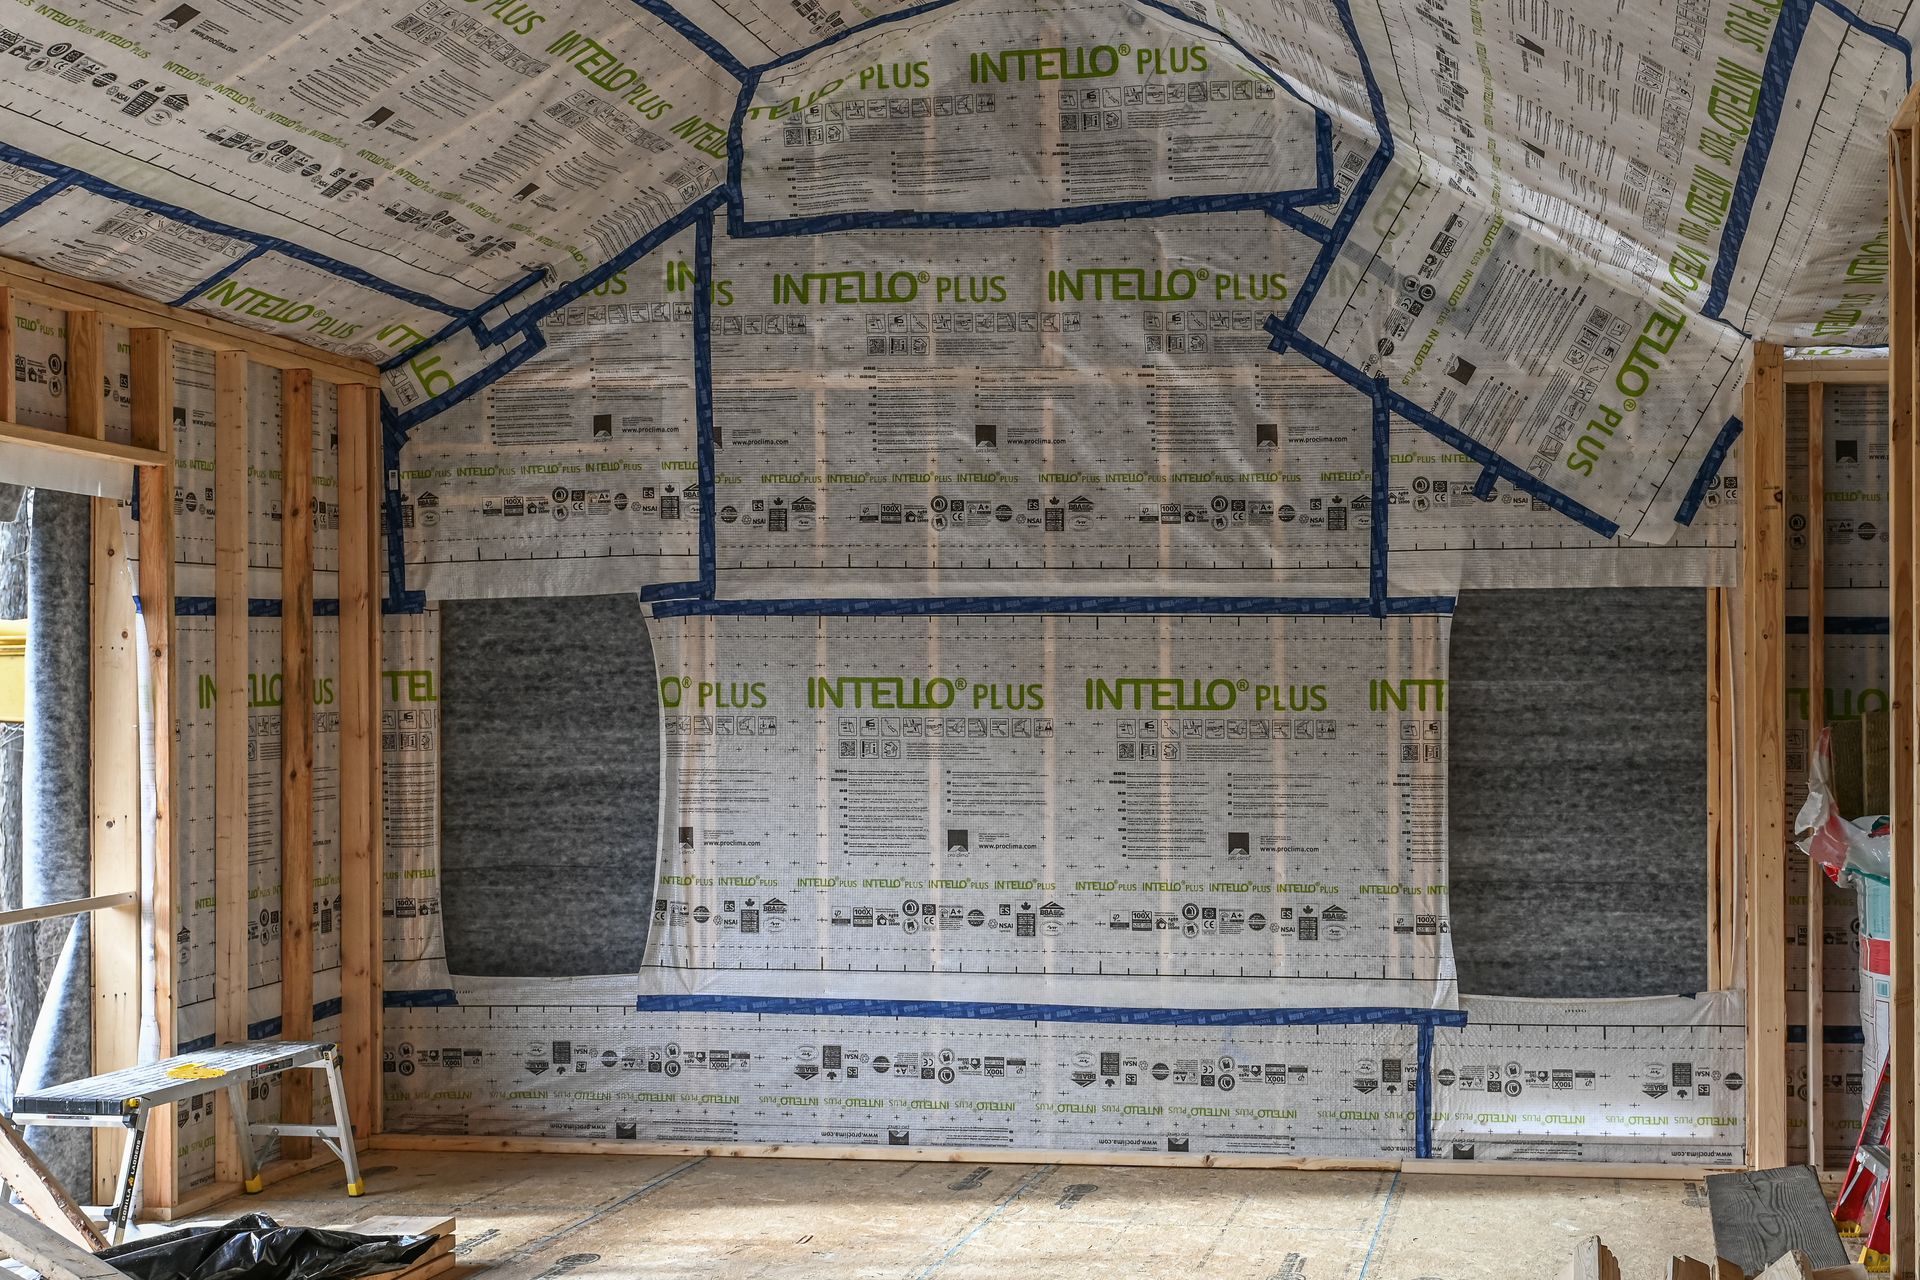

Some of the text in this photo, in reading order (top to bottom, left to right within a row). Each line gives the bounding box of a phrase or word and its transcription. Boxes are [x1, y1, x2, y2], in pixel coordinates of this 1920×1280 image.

[1724, 3, 1772, 54] PLUS
[1137, 46, 1208, 75] PLUS
[859, 61, 930, 90] PLUS
[622, 82, 672, 120] PLUS
[1471, 246, 1484, 266] PLUS
[936, 276, 1008, 304] PLUS
[1215, 273, 1288, 301] PLUS
[1436, 308, 1450, 326] PLUS
[307, 316, 363, 339] PLUS
[1402, 367, 1416, 386] PLUS
[622, 426, 680, 434] www.proclima.com
[1289, 436, 1348, 444] www.proclima.com
[1567, 404, 1622, 477] PLUS
[1417, 456, 1436, 464] PLUS
[563, 465, 581, 474] PLUS
[804, 475, 822, 484] PLUS
[870, 475, 888, 484] PLUS
[934, 475, 952, 484] PLUS
[1000, 475, 1018, 484] PLUS
[1082, 475, 1100, 483] PLUS
[1148, 475, 1166, 483] PLUS
[1215, 474, 1234, 482] PLUS
[1282, 474, 1301, 482] PLUS
[698, 681, 767, 708] PLUS
[973, 684, 1044, 710] PLUS
[1255, 685, 1328, 712] PLUS
[704, 840, 761, 848] www.proclima.com
[696, 878, 713, 886] PLUS
[760, 878, 778, 886] PLUS
[839, 880, 857, 888] PLUS
[905, 880, 923, 888] PLUS
[971, 881, 988, 889] PLUS
[1037, 882, 1056, 890] PLUS
[1186, 884, 1204, 892] PLUS
[1320, 886, 1339, 894] PLUS
[1403, 887, 1422, 895] PLUS
[955, 1100, 973, 1108] PLUS
[1036, 1103, 1053, 1111] PLUS
[1102, 1104, 1120, 1112] PLUS
[1168, 1106, 1187, 1115] PLUS
[1236, 1108, 1254, 1116] PLUS
[1318, 1110, 1336, 1118] PLUS
[1384, 1111, 1403, 1120] PLUS
[1455, 1112, 1473, 1121] PLUS
[1522, 1114, 1541, 1123] PLUS
[1606, 1115, 1624, 1124] PLUS
[1674, 1116, 1693, 1124] PLUS
[821, 1132, 878, 1140] www.proclima.com
[1098, 1138, 1158, 1146] www.proclima.com
[131, 1139, 141, 1175] LADDERS
[1671, 1150, 1733, 1159] www.proclima.com
[122, 1188, 131, 1222] GORILLA
